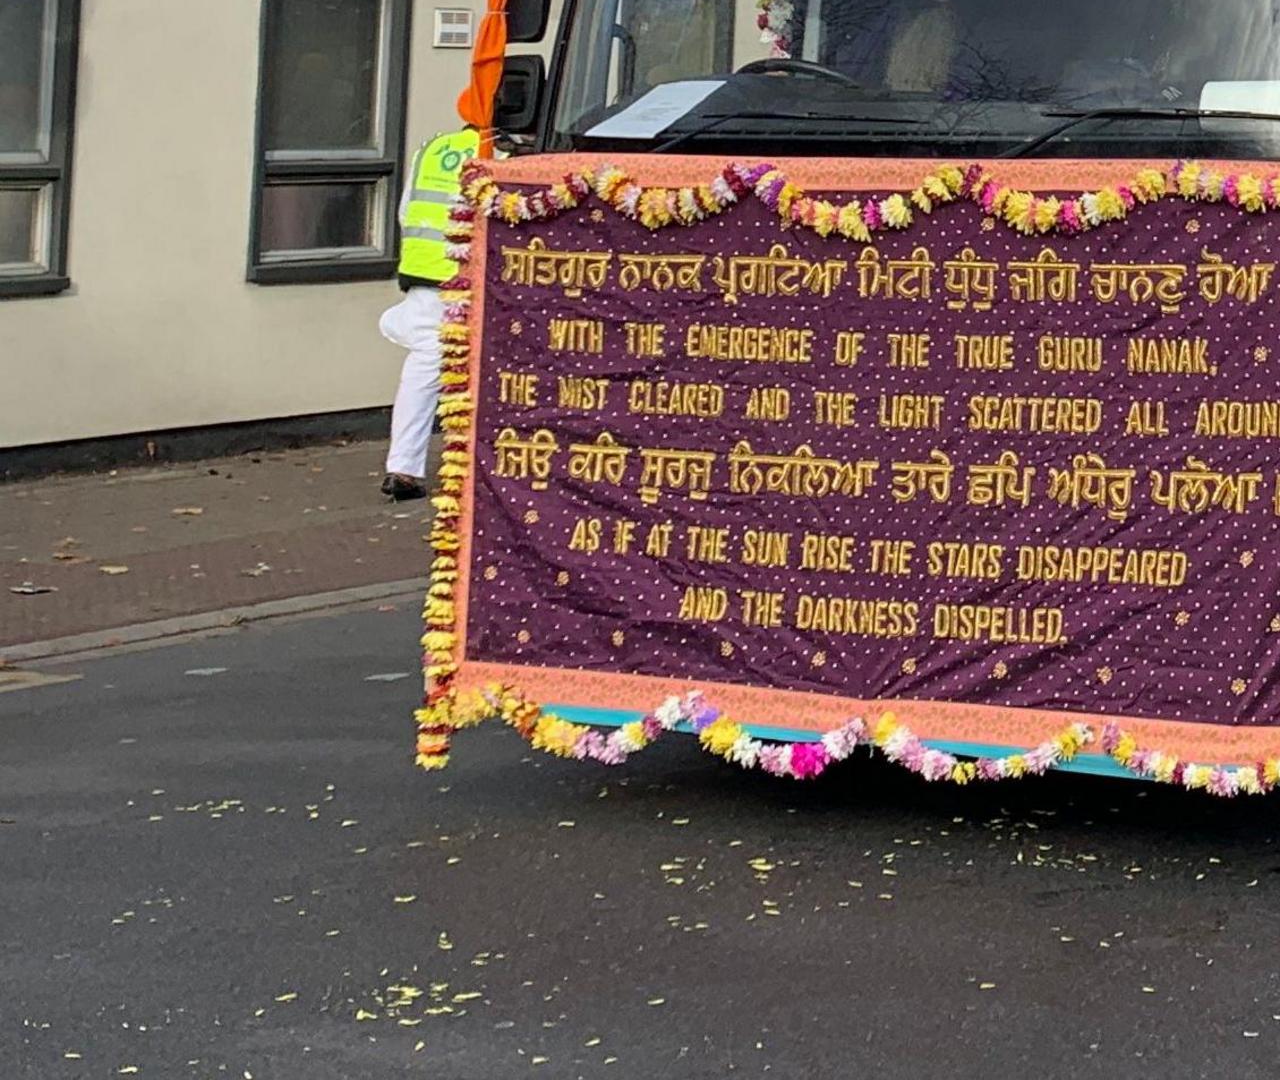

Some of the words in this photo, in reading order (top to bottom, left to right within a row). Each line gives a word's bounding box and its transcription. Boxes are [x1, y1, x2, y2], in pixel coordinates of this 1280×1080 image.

[501, 238, 612, 297] ਸਤਿਗੁਰ
[619, 254, 706, 291] ਨਾਨਕ
[855, 247, 935, 298] ਮਿਟੀ
[1007, 248, 1080, 301] ਜਗਿ
[1090, 263, 1187, 313] ਚਾਨਣੁ
[1197, 245, 1275, 303] ਹੋਆ
[548, 319, 604, 353] WITH
[625, 323, 665, 356] THE
[686, 325, 813, 362] EMERGENCE
[836, 331, 865, 366] OF
[888, 333, 931, 368] THE
[955, 334, 1014, 369] TRUE
[1038, 335, 1102, 371] GURU
[499, 372, 539, 407] THE
[558, 377, 610, 410] MIST
[629, 380, 724, 416] CLEARED
[745, 387, 791, 420] AND
[814, 391, 856, 426] THE
[879, 394, 945, 429] LIGHT
[969, 395, 1101, 433] SCATTERED
[1126, 400, 1170, 436] ALL
[569, 431, 629, 483] ਕਰਿ
[728, 440, 880, 497] ਨਿਕਲਿਆ
[891, 450, 955, 504] ਤਾਰੇ
[967, 450, 1036, 507] ਛਪਿ
[1150, 456, 1263, 515] ਪਲੋਆ
[569, 518, 600, 552] AS
[613, 521, 636, 555] IF
[646, 524, 673, 558] AT
[687, 525, 730, 563] THE
[742, 529, 789, 566] SUN
[801, 532, 855, 571] RISE
[870, 540, 916, 575] THE
[927, 541, 1003, 578] STARS
[1017, 545, 1187, 587] DISAPPEARED
[679, 585, 728, 622] AND
[740, 590, 784, 627] THE
[796, 594, 919, 638] DARKNESS
[933, 603, 1067, 645] DISPELLED.
